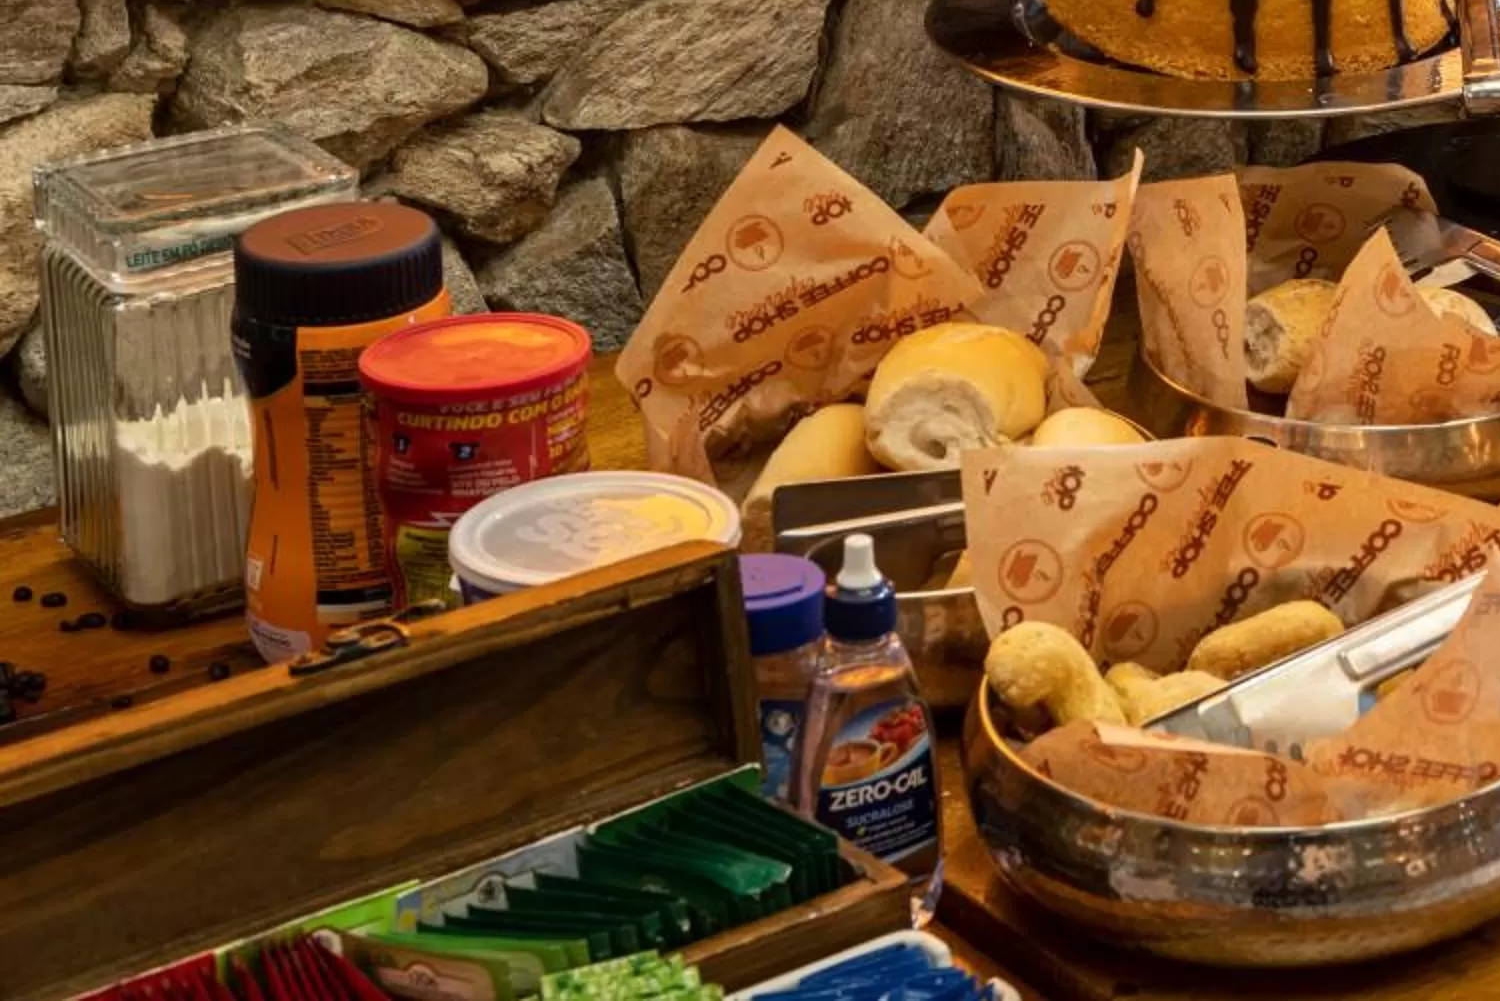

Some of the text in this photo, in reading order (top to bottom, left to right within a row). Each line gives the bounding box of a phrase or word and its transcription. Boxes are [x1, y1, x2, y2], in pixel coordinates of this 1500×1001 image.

[733, 255, 889, 343] COFFEE SHOP
[852, 314, 916, 345] SHOP
[397, 411, 502, 431] CURTINDO
[508, 402, 548, 424] COM
[1171, 512, 1218, 580] SHOP
[1323, 518, 1404, 605] COFFEE
[829, 766, 929, 812] ZERO-CAL
